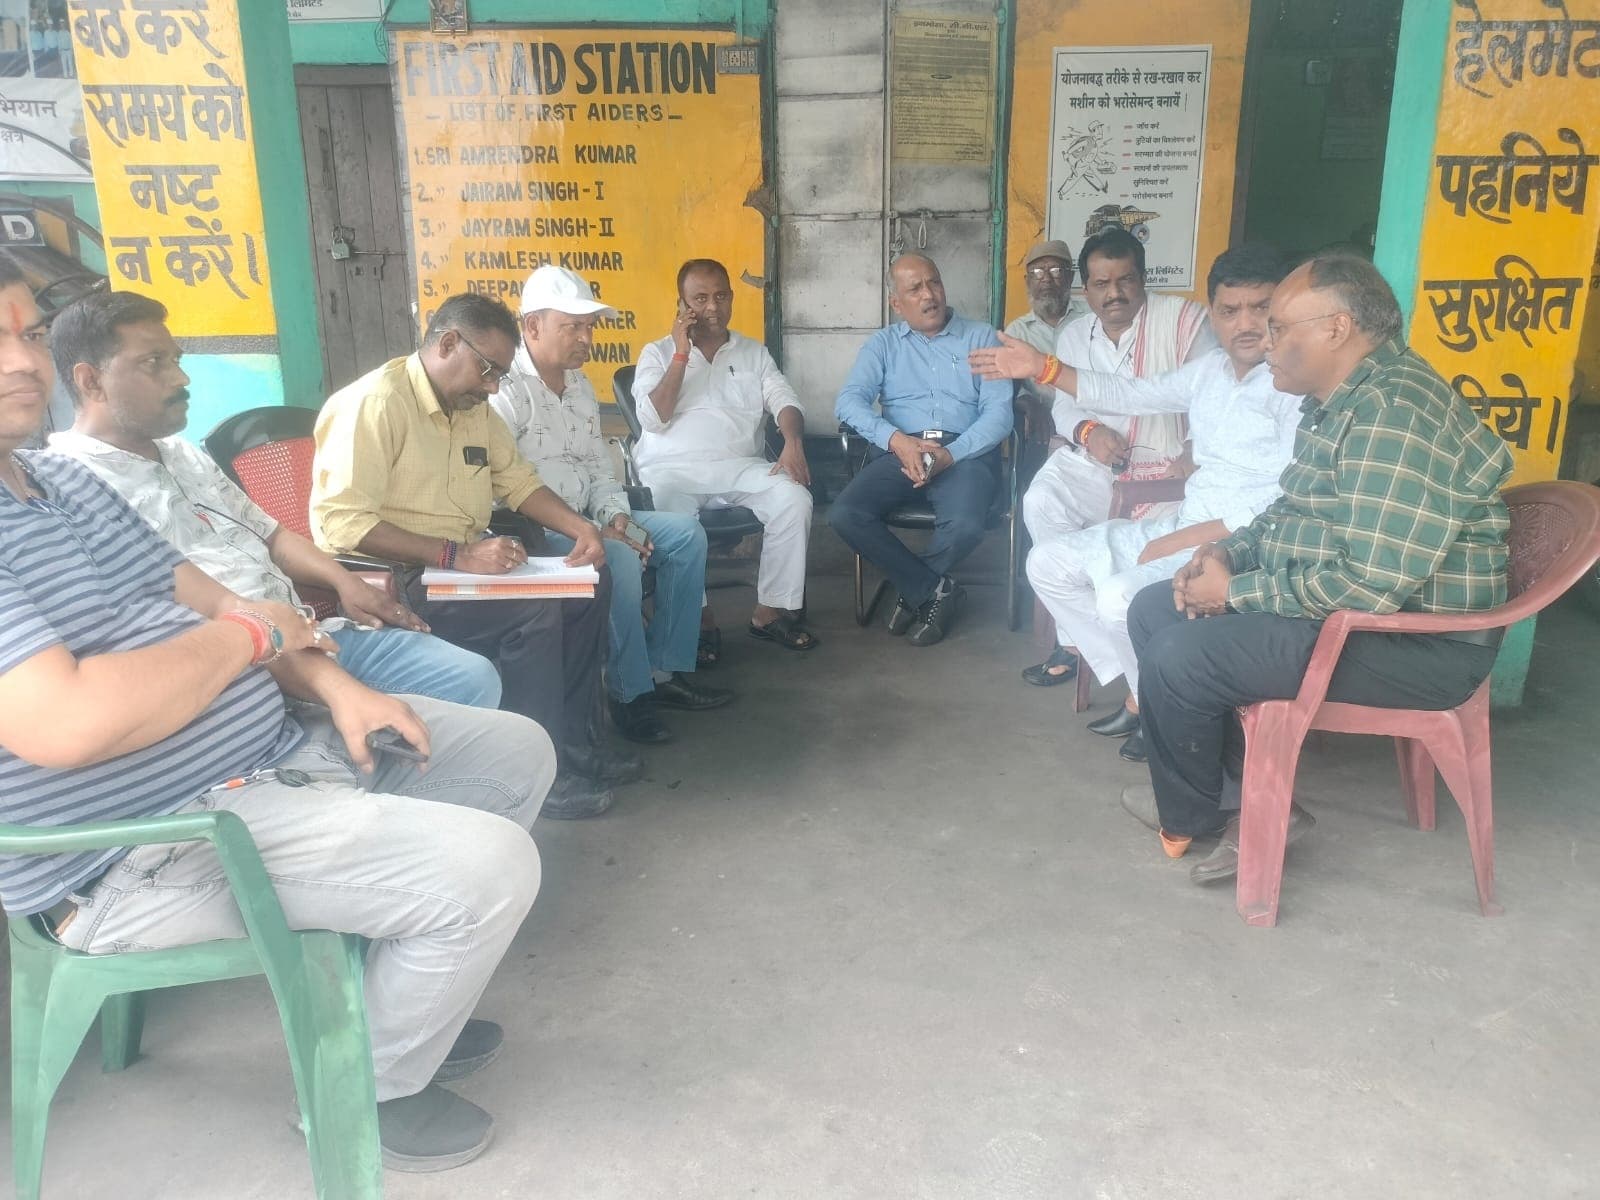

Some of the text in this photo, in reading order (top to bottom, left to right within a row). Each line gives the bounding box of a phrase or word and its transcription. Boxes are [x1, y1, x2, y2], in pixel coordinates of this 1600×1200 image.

[403, 42, 716, 97] FIRST AID STATION
[1105, 68, 1130, 85] तरीके
[1132, 68, 1141, 84] से
[1143, 71, 1185, 85] रख-रखाव
[1187, 71, 1202, 84] कर
[82, 62, 247, 149] समय को
[1069, 92, 1096, 110] मशीन
[1098, 92, 1111, 109] को
[1113, 92, 1155, 110] भरोसेमन्द
[1156, 91, 1181, 109] बनायें
[449, 102, 664, 123] LIST OF FIRST AIDERS
[460, 145, 559, 165] AMRENDRA
[575, 144, 637, 164] KUMAR
[1436, 127, 1599, 225] पहनिये
[124, 164, 221, 216] नष्ट
[461, 181, 522, 202] JAIRAM
[461, 217, 531, 238] JAYRAM
[109, 236, 152, 285] न
[464, 251, 551, 270] KAMLESH
[559, 251, 624, 272] KUMAR
[466, 279, 524, 298] DEEPA
[1423, 254, 1584, 353] सुरक्षित
